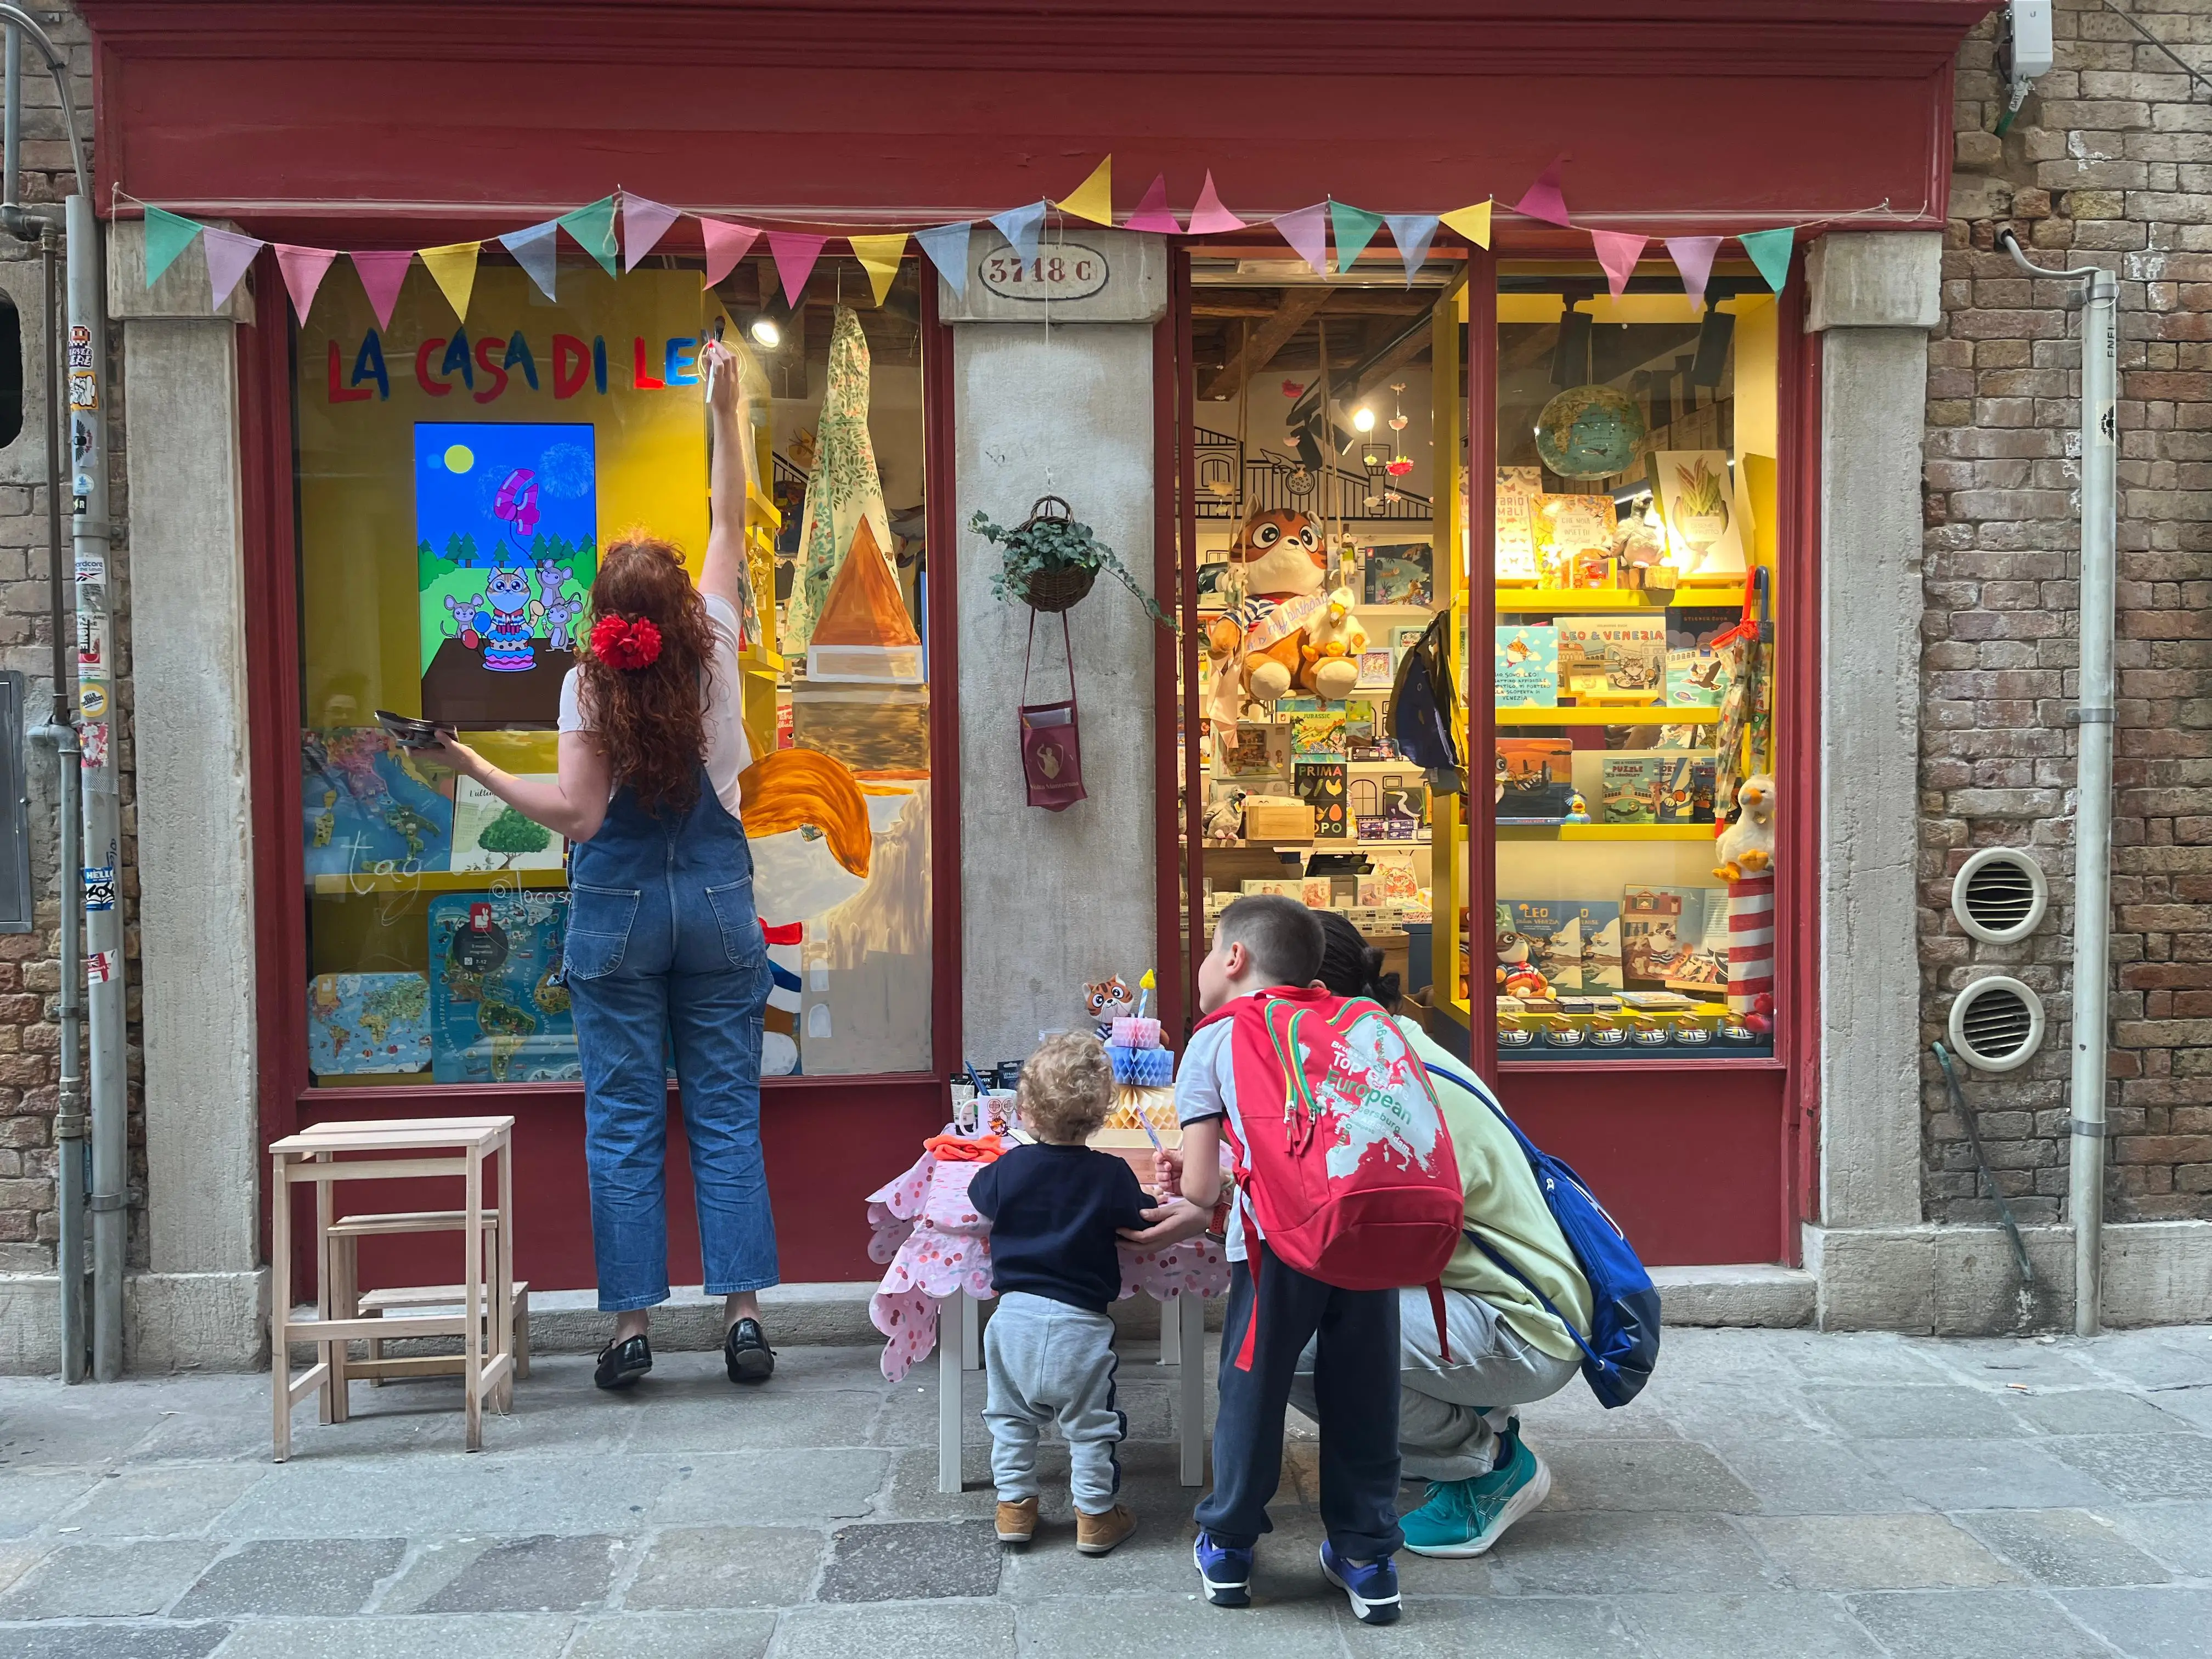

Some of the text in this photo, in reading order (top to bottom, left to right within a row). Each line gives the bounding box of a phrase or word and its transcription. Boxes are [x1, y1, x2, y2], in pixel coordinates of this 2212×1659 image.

[989, 257, 1091, 283] 3718 C
[329, 326, 699, 404] LA CASA DI LE
[1561, 630, 1664, 641] LEO & VENEZIA
[1299, 766, 1343, 776] PRIMA
[340, 830, 423, 927] tag
[1524, 907, 1549, 918] LEO
[1333, 1050, 1361, 1076] Top
[1325, 1069, 1412, 1125] European
